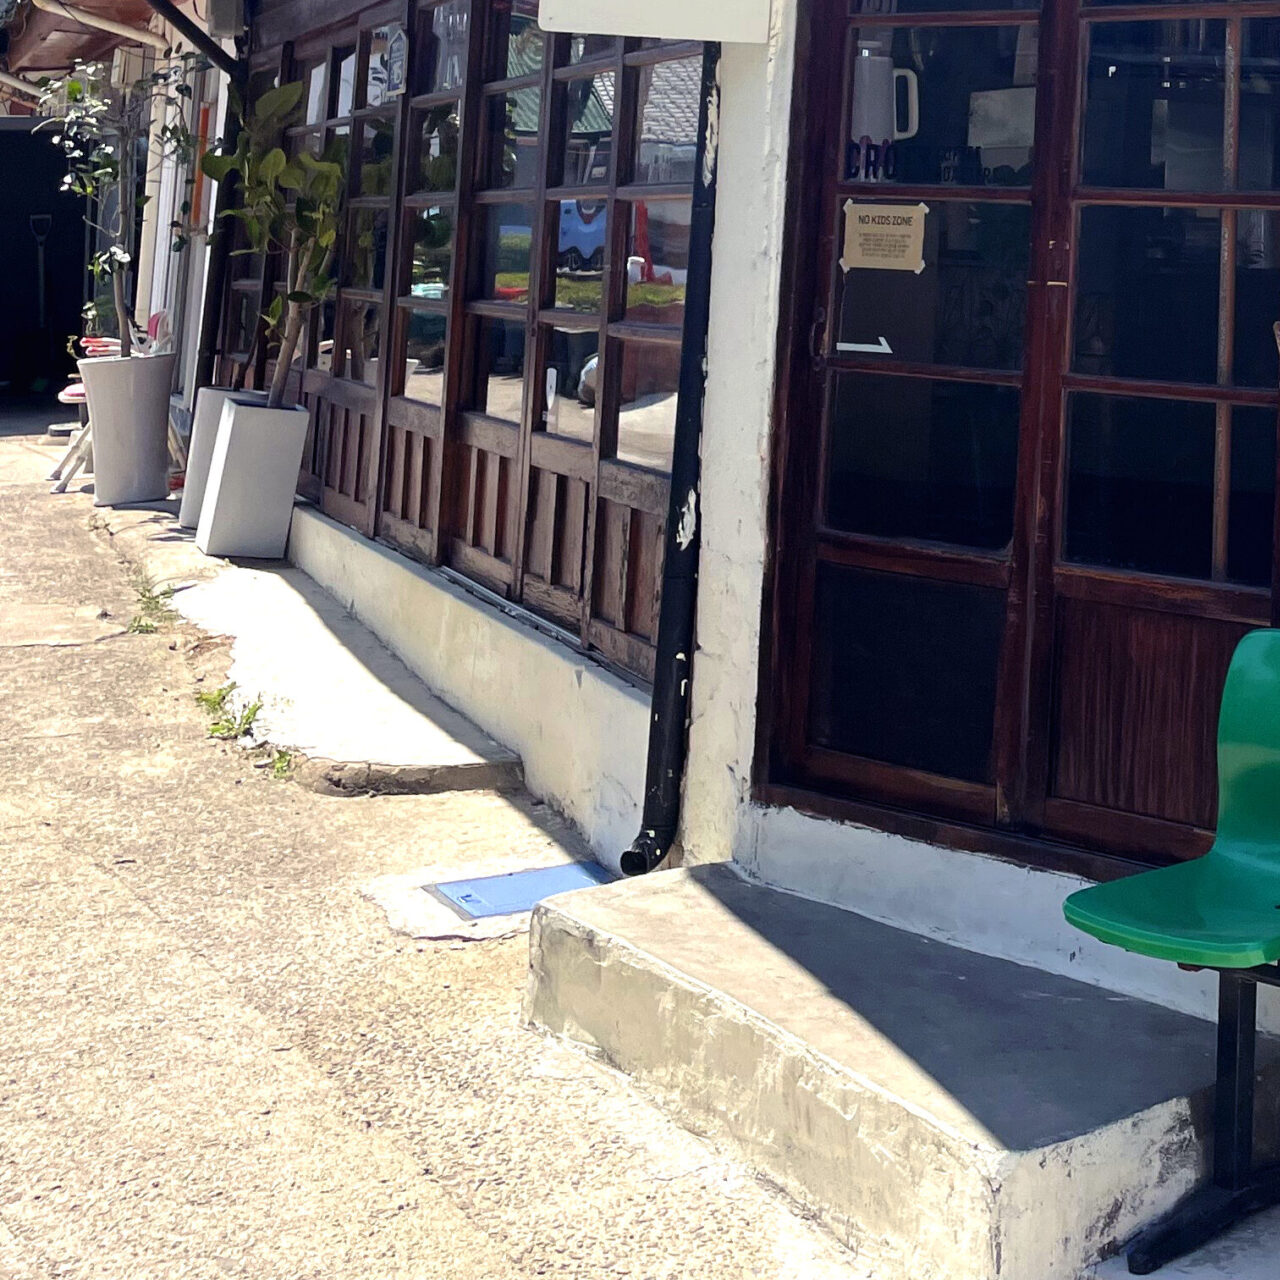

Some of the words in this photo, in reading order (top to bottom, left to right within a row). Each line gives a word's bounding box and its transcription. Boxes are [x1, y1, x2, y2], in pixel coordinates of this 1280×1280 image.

[858, 215, 870, 226] NO
[871, 215, 891, 226] KIDS
[892, 216, 913, 226] ZONE
